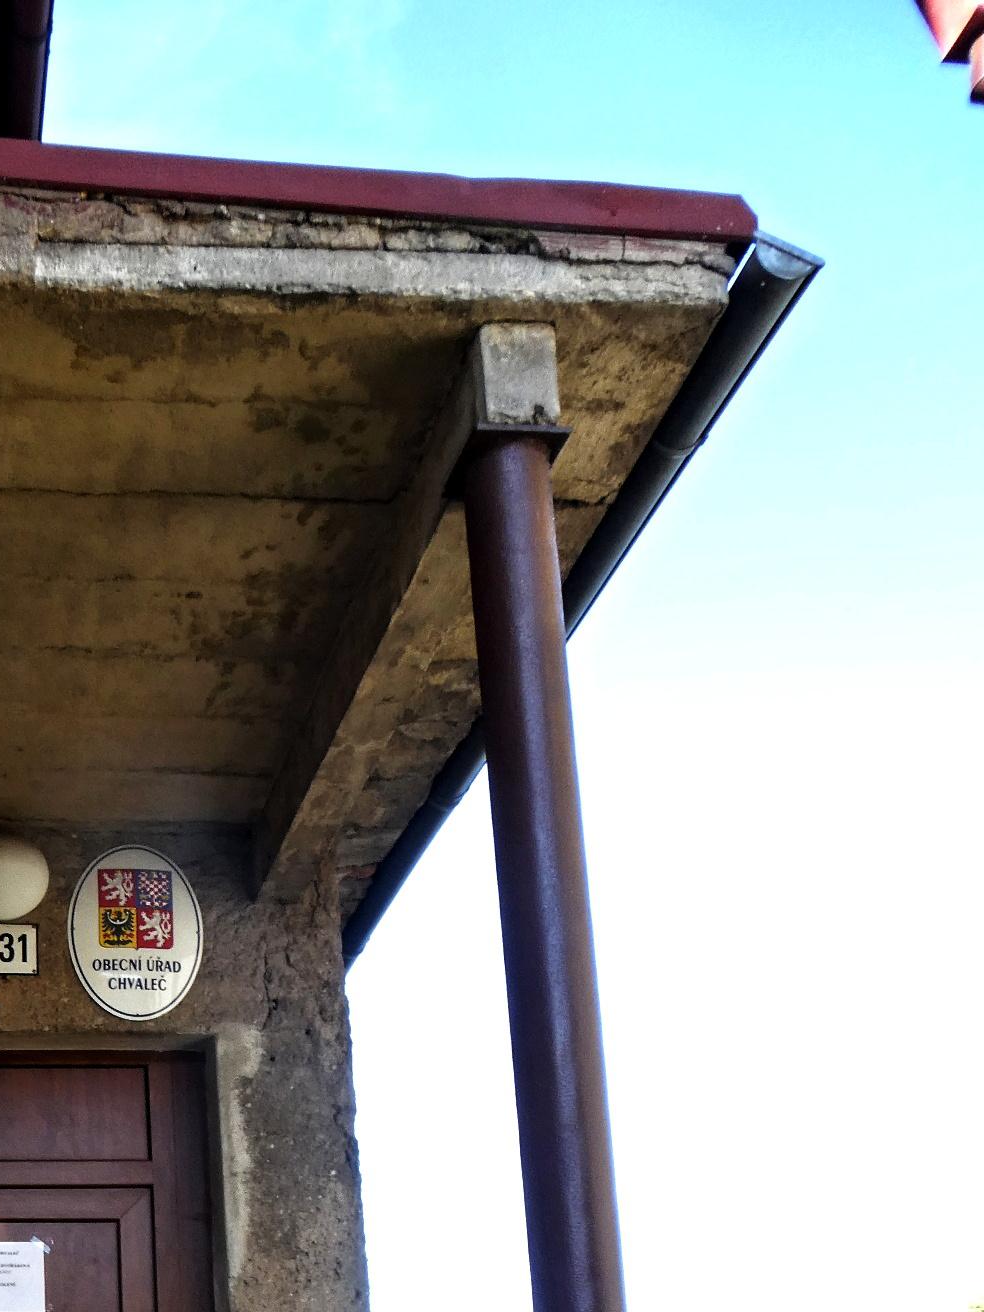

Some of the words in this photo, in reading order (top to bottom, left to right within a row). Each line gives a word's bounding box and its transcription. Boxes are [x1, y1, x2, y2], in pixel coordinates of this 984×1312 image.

[92, 956, 143, 973] OBECNÍ
[146, 956, 182, 973] ÚŘAD
[108, 975, 167, 991] CHVALEČ
